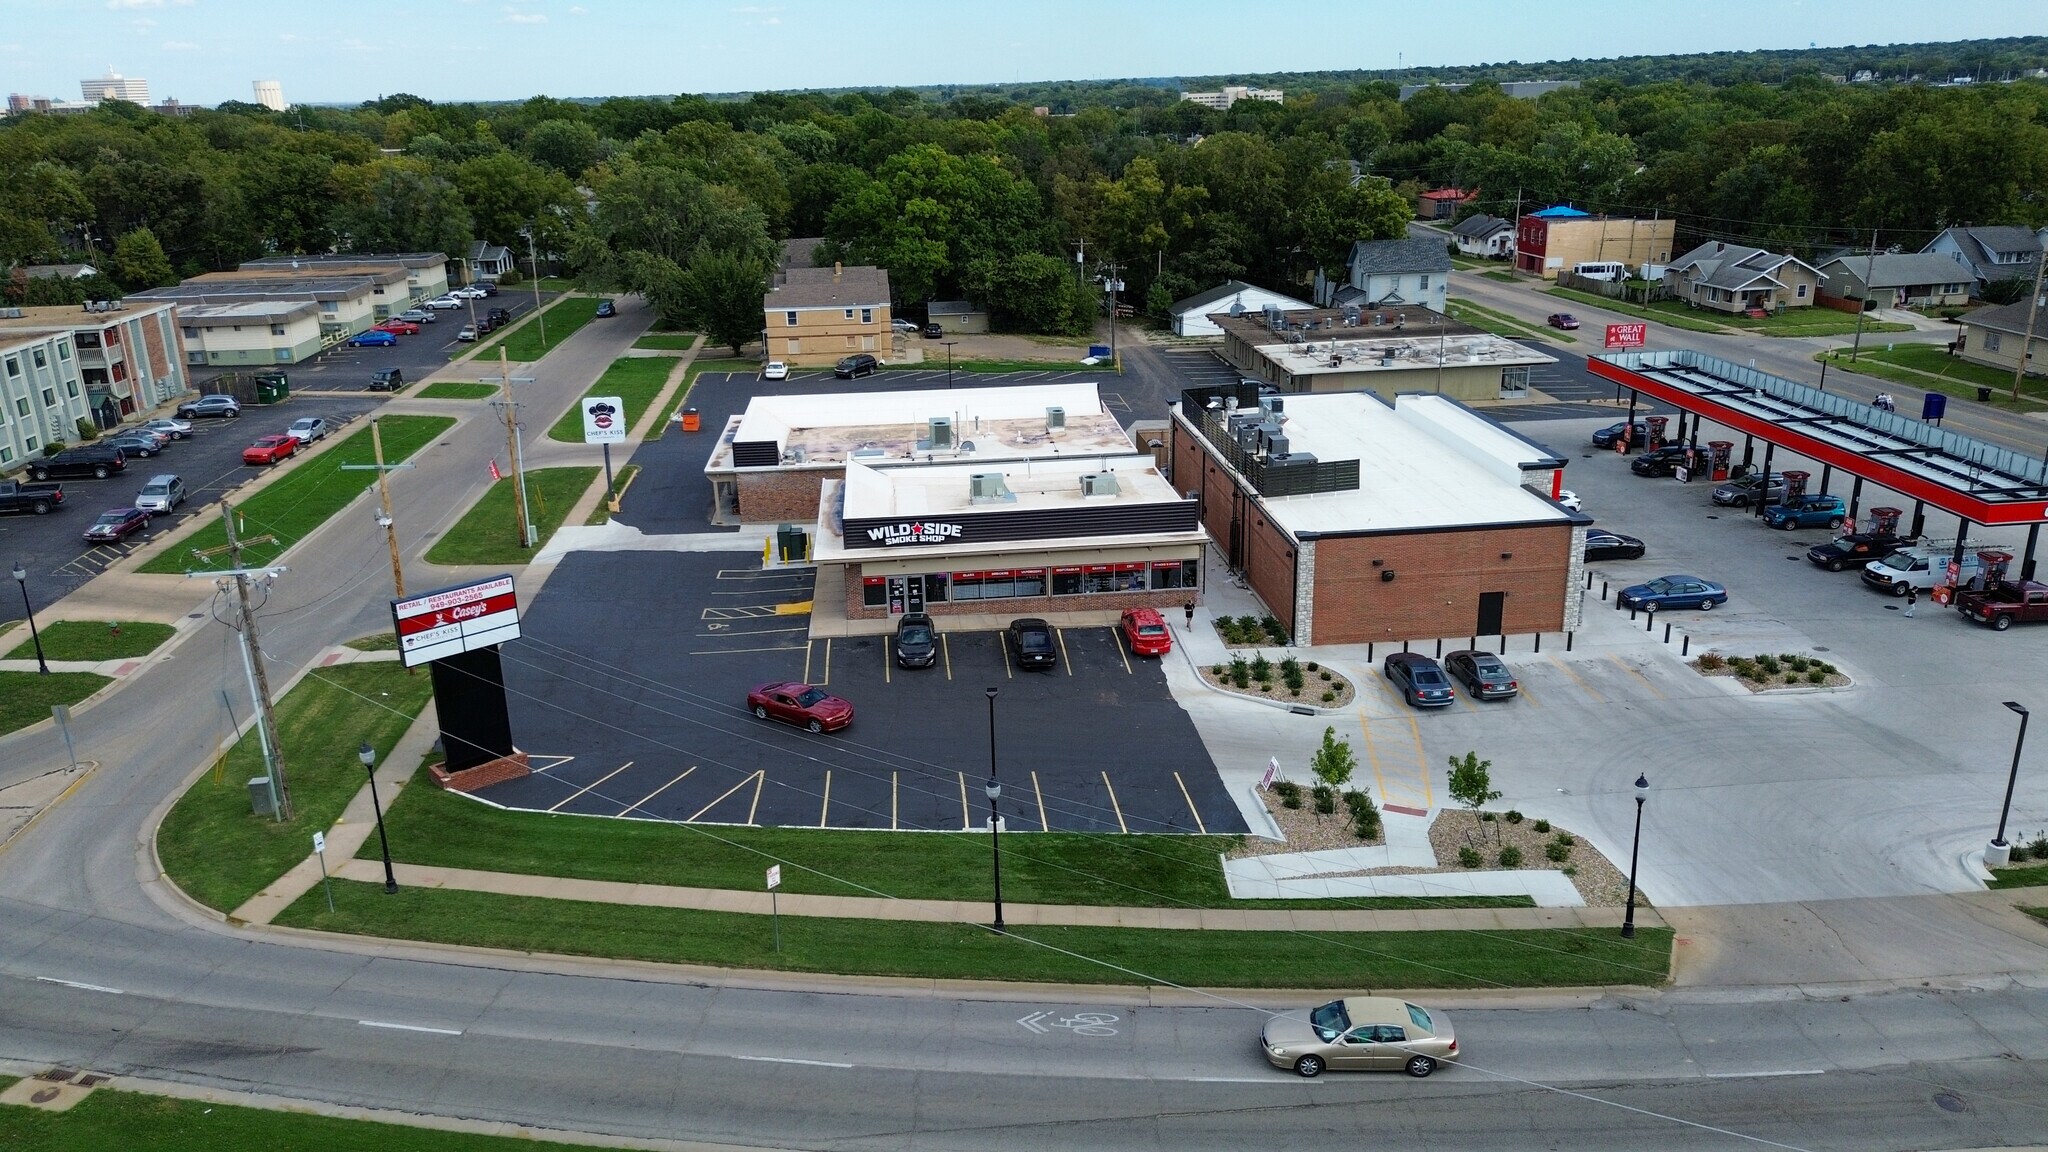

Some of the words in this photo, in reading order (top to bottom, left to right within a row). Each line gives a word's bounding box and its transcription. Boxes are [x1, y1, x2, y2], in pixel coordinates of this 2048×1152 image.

[1617, 325, 1643, 333] GREAT
[1619, 333, 1640, 341] WALL
[867, 523, 910, 541] WILD
[924, 523, 962, 537] SIDE
[885, 535, 917, 546] SMOKE
[398, 601, 422, 611] RETAIL
[428, 587, 476, 603] RESTAURANTS
[476, 579, 510, 592] AVAILABLE
[430, 592, 484, 610] 949-903-2565
[452, 602, 487, 619] Casey's
[416, 631, 440, 642] CHEF'S
[442, 626, 459, 635] KISS
